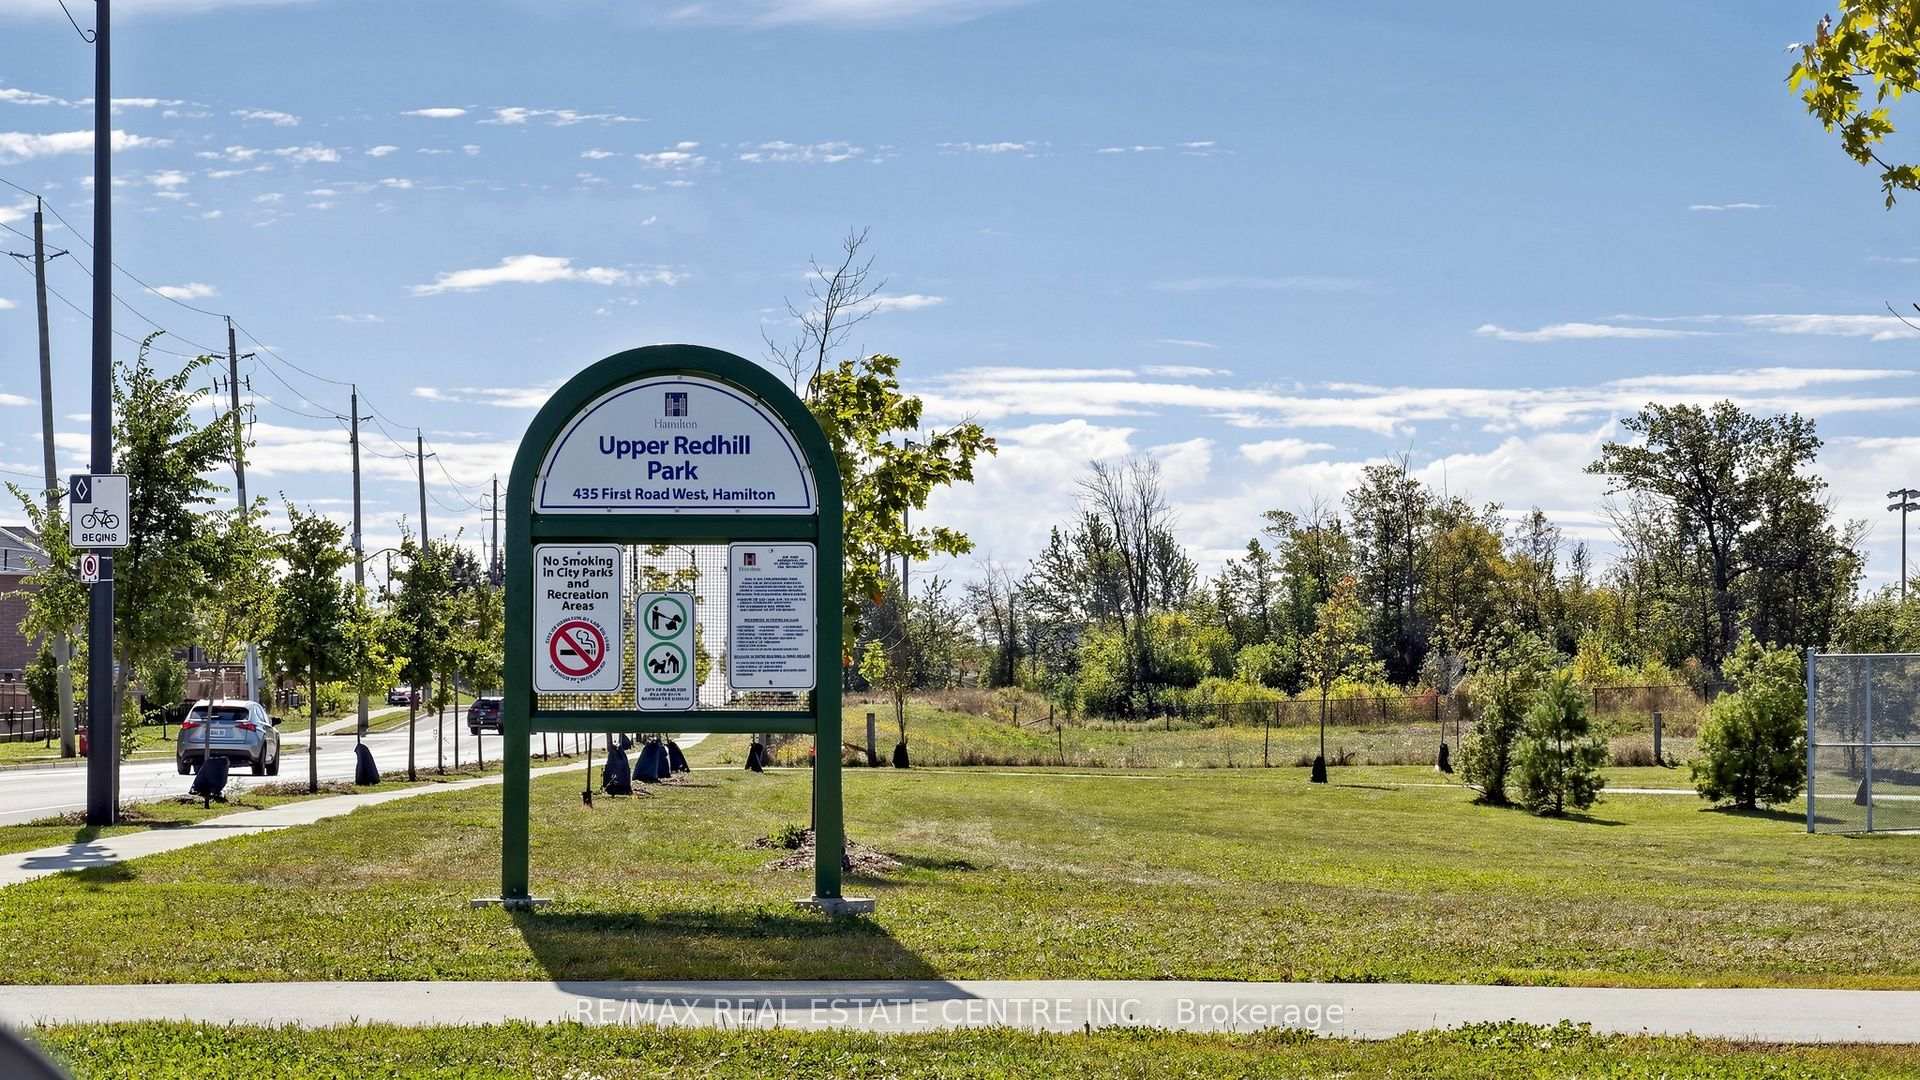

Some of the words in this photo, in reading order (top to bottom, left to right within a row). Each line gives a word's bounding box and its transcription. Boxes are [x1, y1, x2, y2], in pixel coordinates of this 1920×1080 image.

[654, 418, 698, 429] Hamilton
[599, 435, 669, 459] Upper
[674, 435, 750, 455] Redhill
[647, 460, 698, 480] Park
[572, 488, 599, 500] 435
[601, 487, 632, 500] First
[636, 487, 670, 500] Road
[672, 488, 709, 502] West,
[712, 487, 776, 500] Hamilton
[81, 533, 117, 543] BEGINS
[543, 555, 559, 566] No
[562, 555, 613, 568] Smoking
[543, 567, 554, 577] in
[556, 567, 580, 579] City
[582, 567, 613, 577] Parks
[567, 579, 590, 588] and
[547, 589, 609, 600] Recreation
[561, 601, 594, 611] Areas
